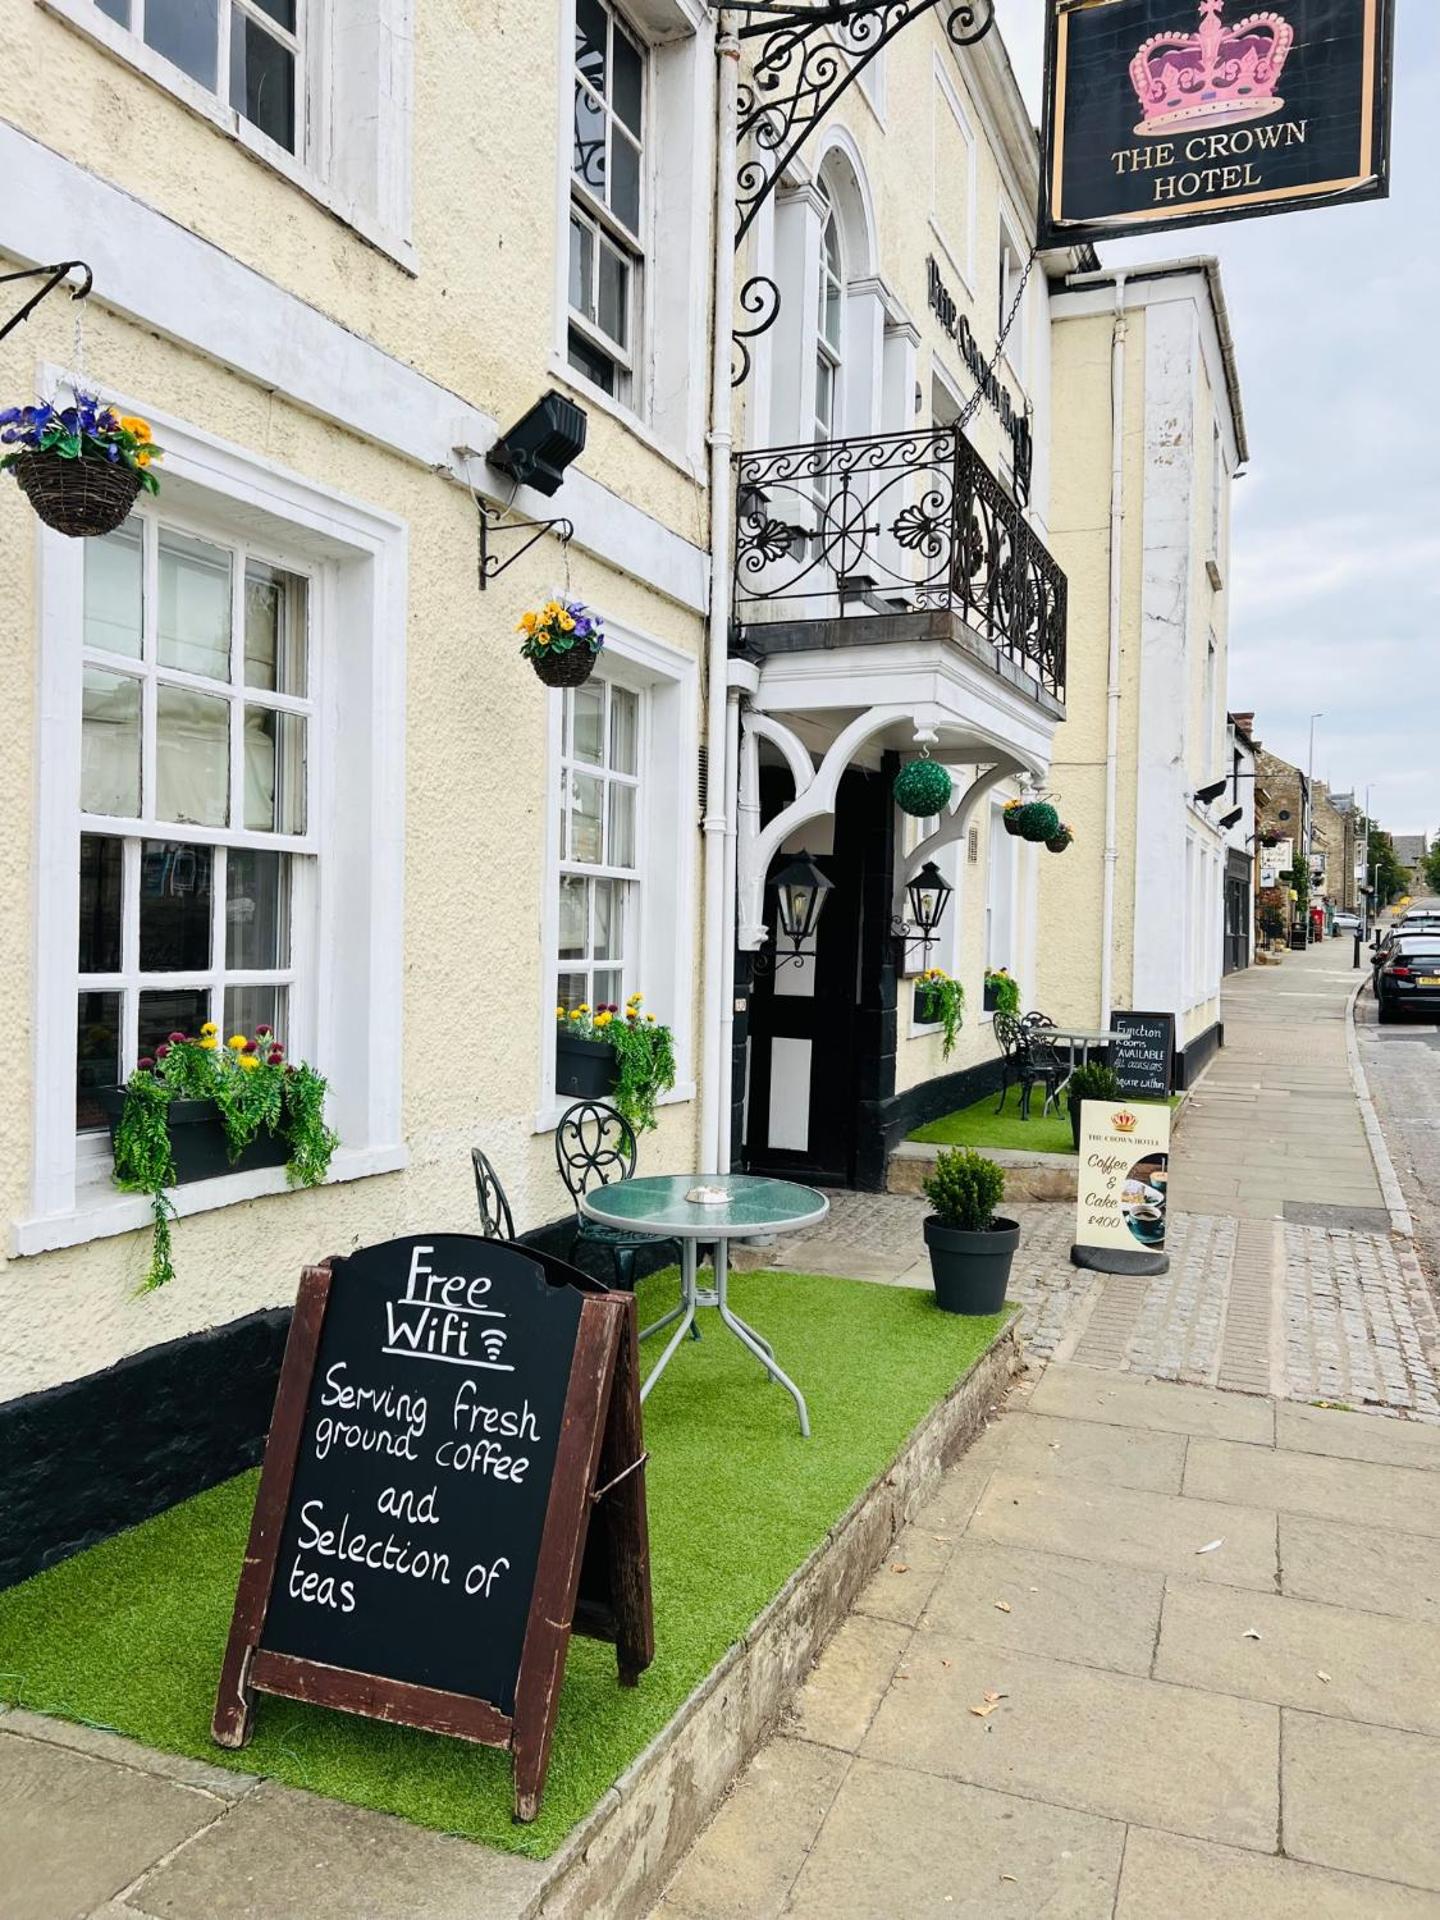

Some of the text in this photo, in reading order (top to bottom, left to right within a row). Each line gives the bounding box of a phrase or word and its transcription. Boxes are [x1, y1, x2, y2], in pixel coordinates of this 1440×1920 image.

[1111, 119, 1309, 175] THE CROWN
[1153, 163, 1262, 202] HOTEL
[1087, 1153, 1129, 1175] Coffee
[1106, 1176, 1117, 1190] &
[1084, 1192, 1119, 1209] Cake
[406, 1246, 492, 1308] Free
[386, 1301, 469, 1357] Wifi
[320, 1361, 541, 1442] Serving fresh
[315, 1417, 530, 1483] ground coffee
[377, 1486, 440, 1524] and
[298, 1500, 511, 1598] Selection of
[288, 1553, 356, 1613] teas
